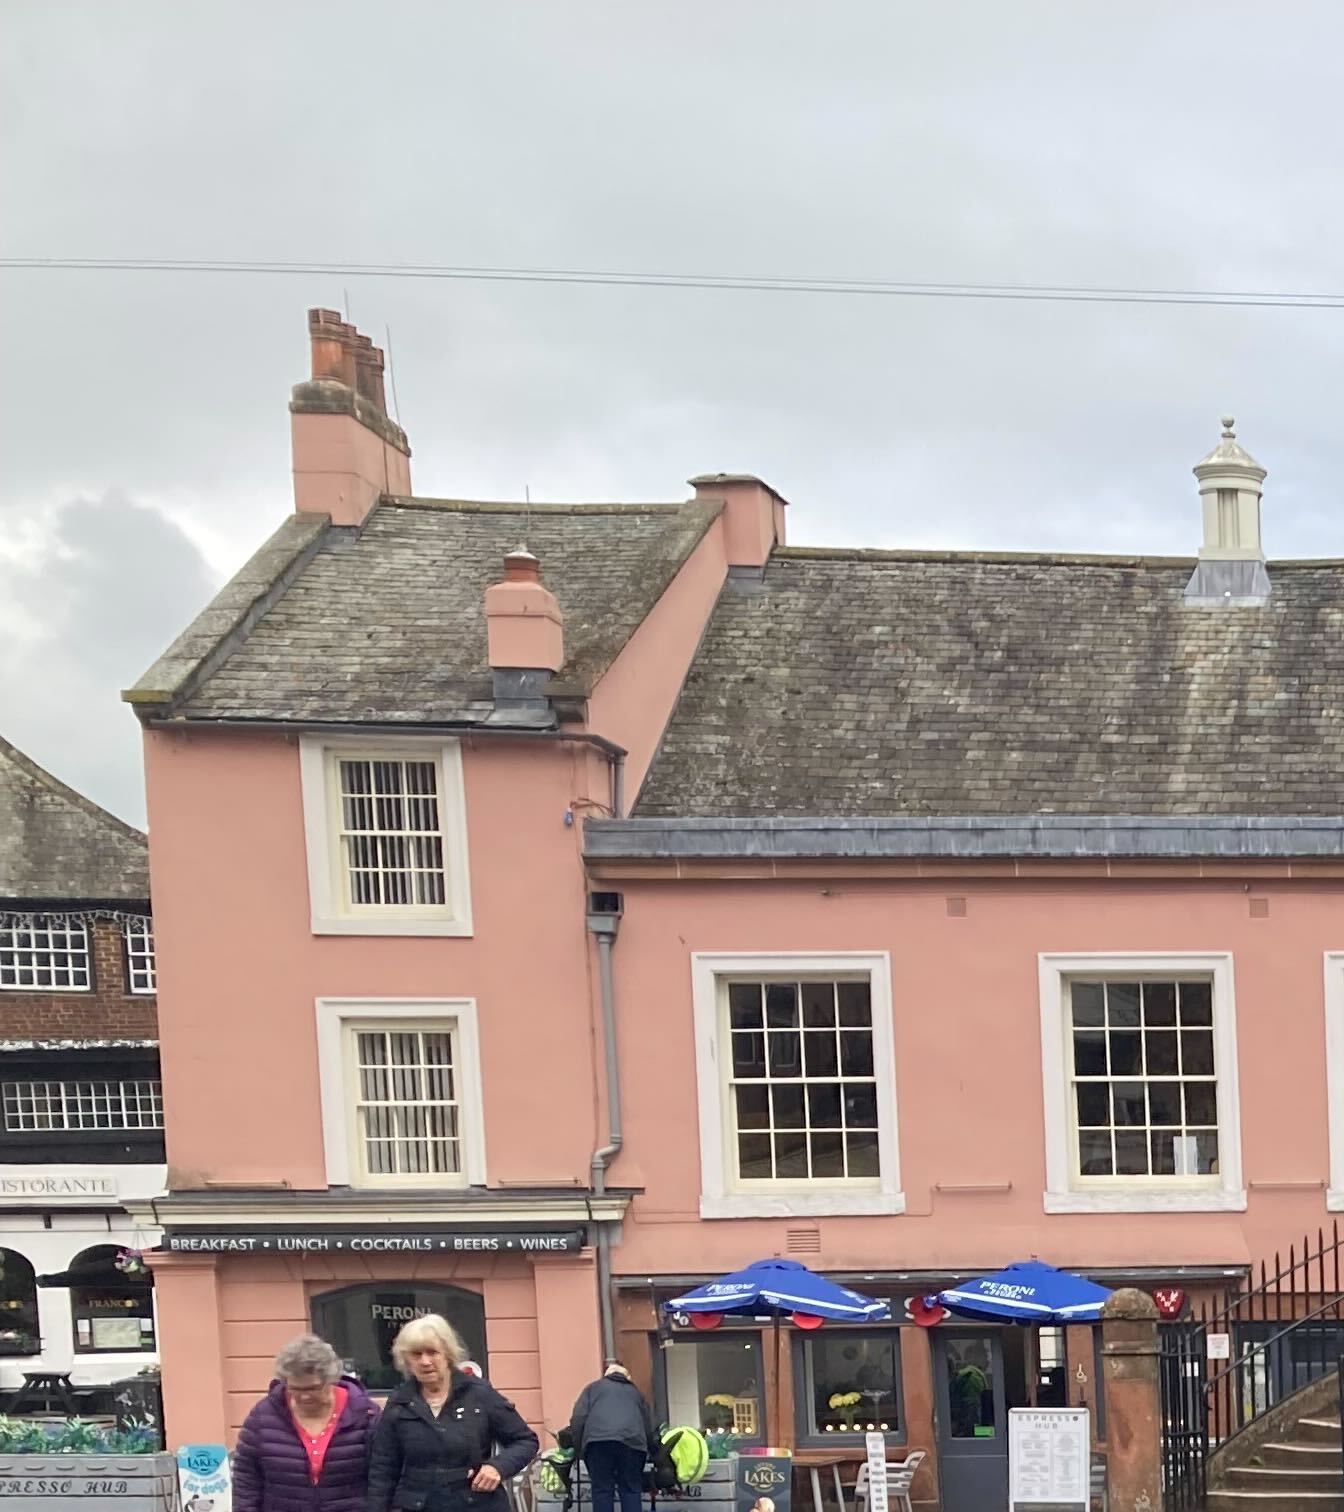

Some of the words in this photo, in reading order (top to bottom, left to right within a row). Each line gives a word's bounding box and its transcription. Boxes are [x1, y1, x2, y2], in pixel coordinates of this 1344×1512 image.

[170, 1238, 256, 1251] BREAKFAST
[277, 1238, 328, 1251] LUNCH
[351, 1238, 432, 1251] COCKTAILS
[454, 1237, 498, 1250] BEERS
[520, 1237, 567, 1250] WINES
[980, 1280, 1035, 1296] PERONI
[187, 1457, 220, 1468] LAKES
[744, 1470, 785, 1484] LAKES
[84, 1480, 128, 1494] HUB
